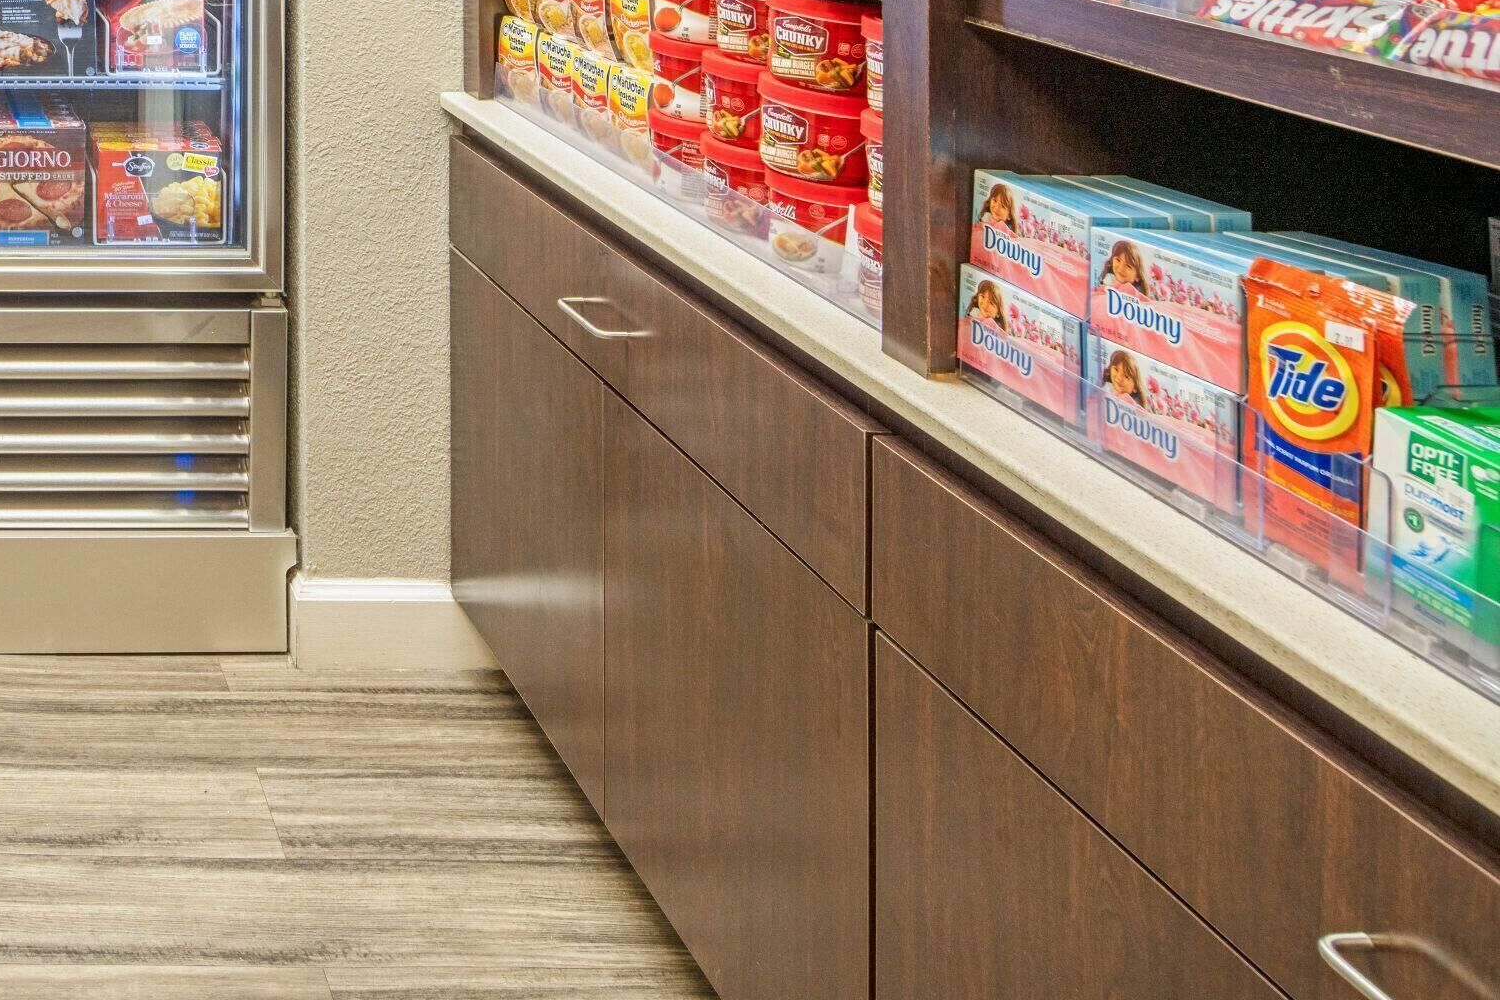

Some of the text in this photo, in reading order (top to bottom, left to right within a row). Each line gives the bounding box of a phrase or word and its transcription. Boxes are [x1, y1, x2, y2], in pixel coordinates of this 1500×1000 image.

[621, 0, 637, 12] Lunch
[782, 20, 812, 33] Campbell's
[508, 36, 526, 47] Instant
[776, 25, 824, 50] CHUNKY
[510, 43, 524, 53] Lunch
[547, 54, 567, 68] Instant
[549, 62, 564, 74] Lunch
[793, 61, 815, 69] BURGER
[579, 59, 604, 79] Maruchan
[579, 71, 597, 86] Instant
[581, 81, 596, 92] Lunch
[617, 75, 645, 97] Maruchan
[618, 90, 637, 105] Instant
[620, 99, 636, 112] Lunch
[767, 108, 793, 122] Campbell's
[763, 114, 804, 139] CHUNKY
[186, 156, 214, 166] Classic
[0, 172, 51, 180] STUFFED
[984, 225, 1042, 276] Downy
[1256, 295, 1264, 307] 1
[1107, 288, 1182, 345] Downy
[971, 320, 1033, 377] Downy
[1267, 343, 1347, 412] Tide
[1104, 397, 1178, 459] Downy
[1411, 443, 1460, 468] OPTI-
[1411, 459, 1460, 486] FREE
